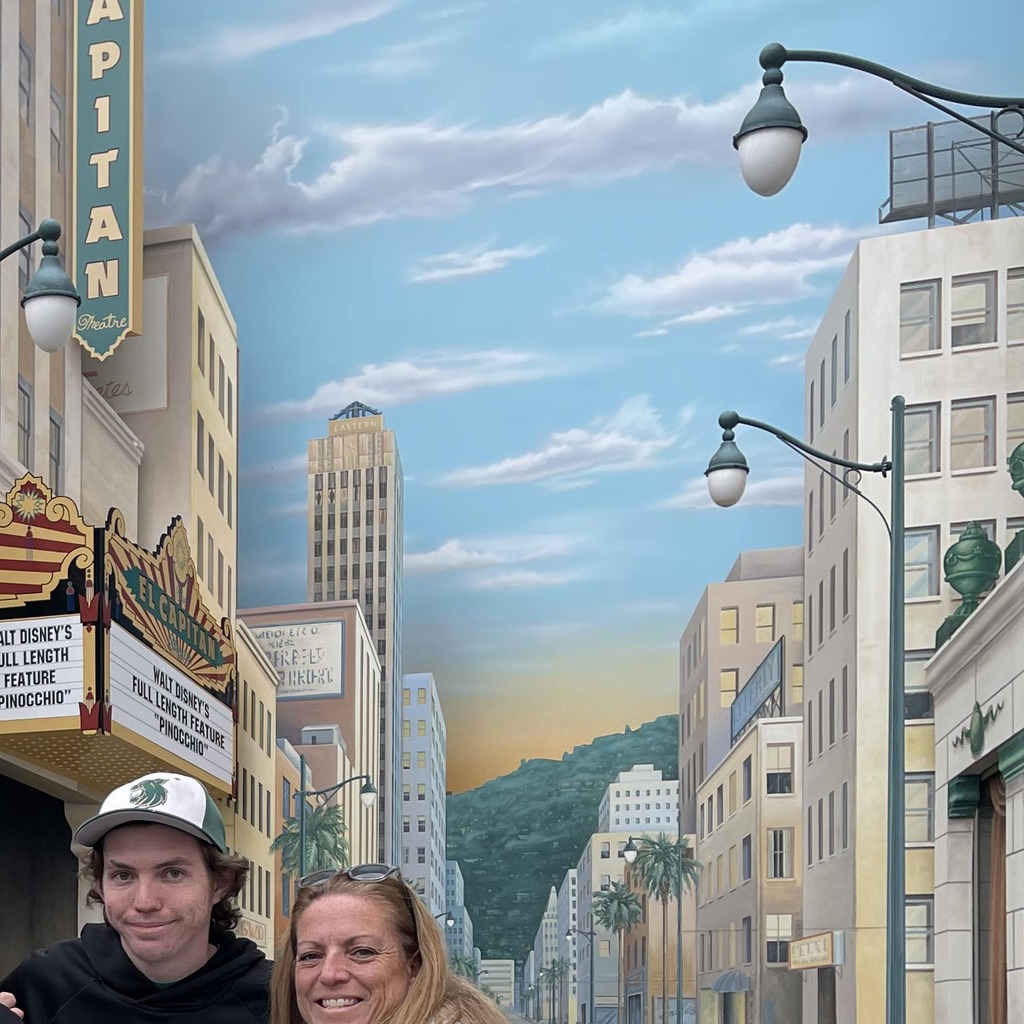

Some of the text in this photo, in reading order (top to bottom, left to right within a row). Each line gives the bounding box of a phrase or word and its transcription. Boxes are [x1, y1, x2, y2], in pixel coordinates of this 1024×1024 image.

[77, 313, 128, 331] Theatre
[333, 420, 377, 433] EASTERN
[139, 573, 216, 661] EL CAPITAN
[20, 624, 73, 644] DISNEY'S
[23, 647, 69, 665] LENGTH
[4, 670, 56, 688] FEATURE
[153, 665, 210, 719] WALT DISNEY'S
[132, 675, 225, 749] FULL LENGTH FEATURE
[154, 712, 209, 756] "PINOCCHIO"
